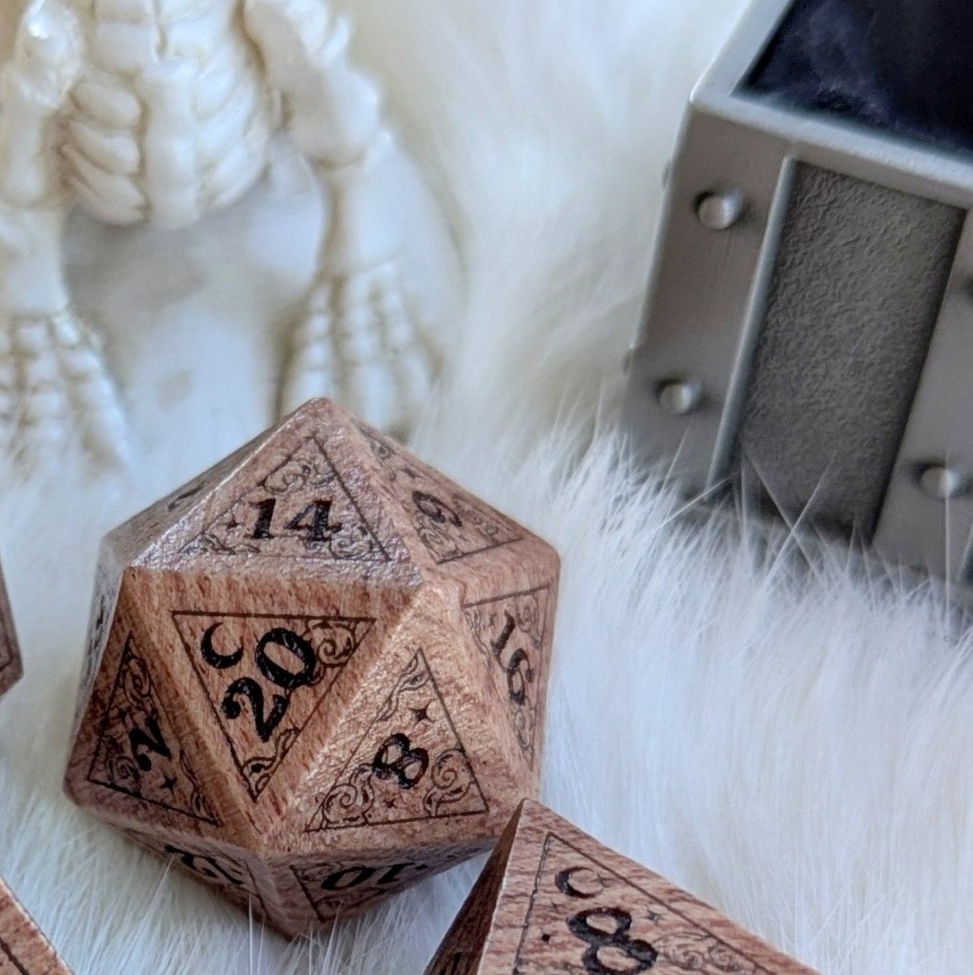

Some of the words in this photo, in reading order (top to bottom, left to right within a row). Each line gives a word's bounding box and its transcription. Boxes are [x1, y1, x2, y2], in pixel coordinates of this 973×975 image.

[250, 498, 341, 541] 14
[220, 626, 319, 742] 20
[490, 609, 535, 706] 16
[128, 715, 172, 773] 2
[372, 732, 430, 790] 8
[320, 861, 417, 891] 10
